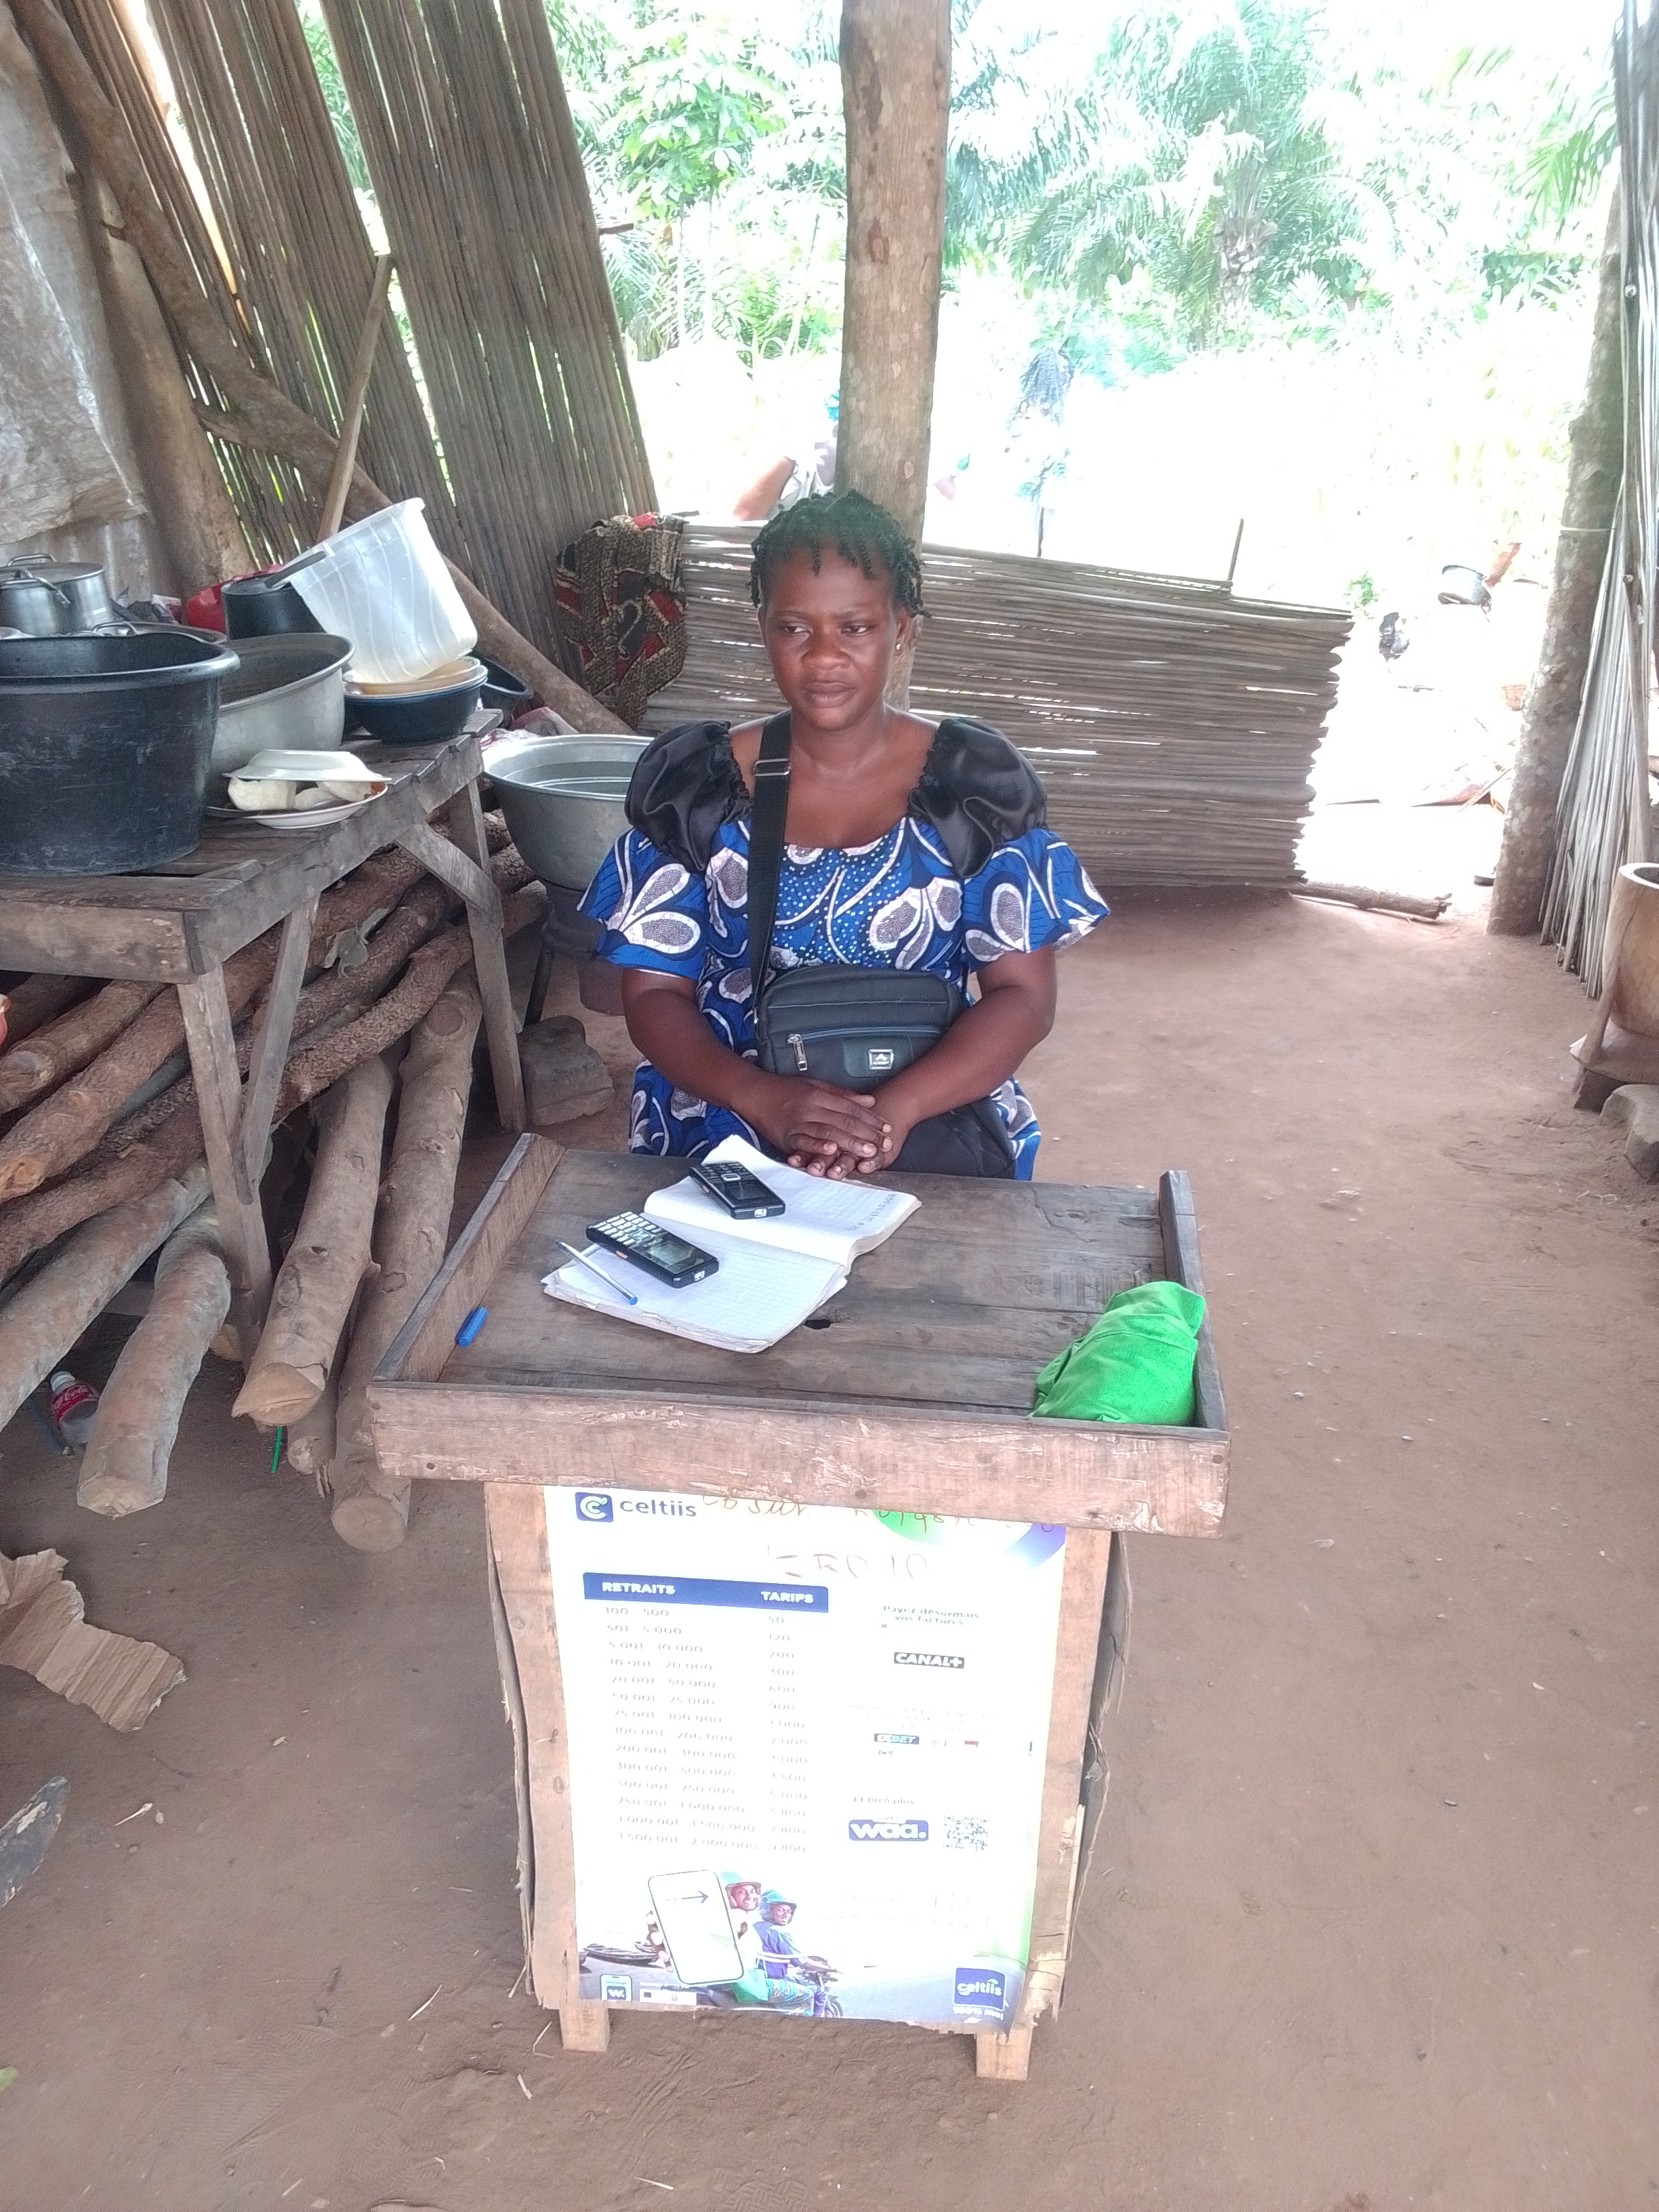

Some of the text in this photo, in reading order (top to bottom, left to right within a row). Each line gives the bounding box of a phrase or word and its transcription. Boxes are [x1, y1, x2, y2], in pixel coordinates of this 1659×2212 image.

[619, 1499, 697, 1517] celtiis
[602, 1582, 814, 1603] RETRAITS TARIFS
[895, 1653, 963, 1667] CANAL+
